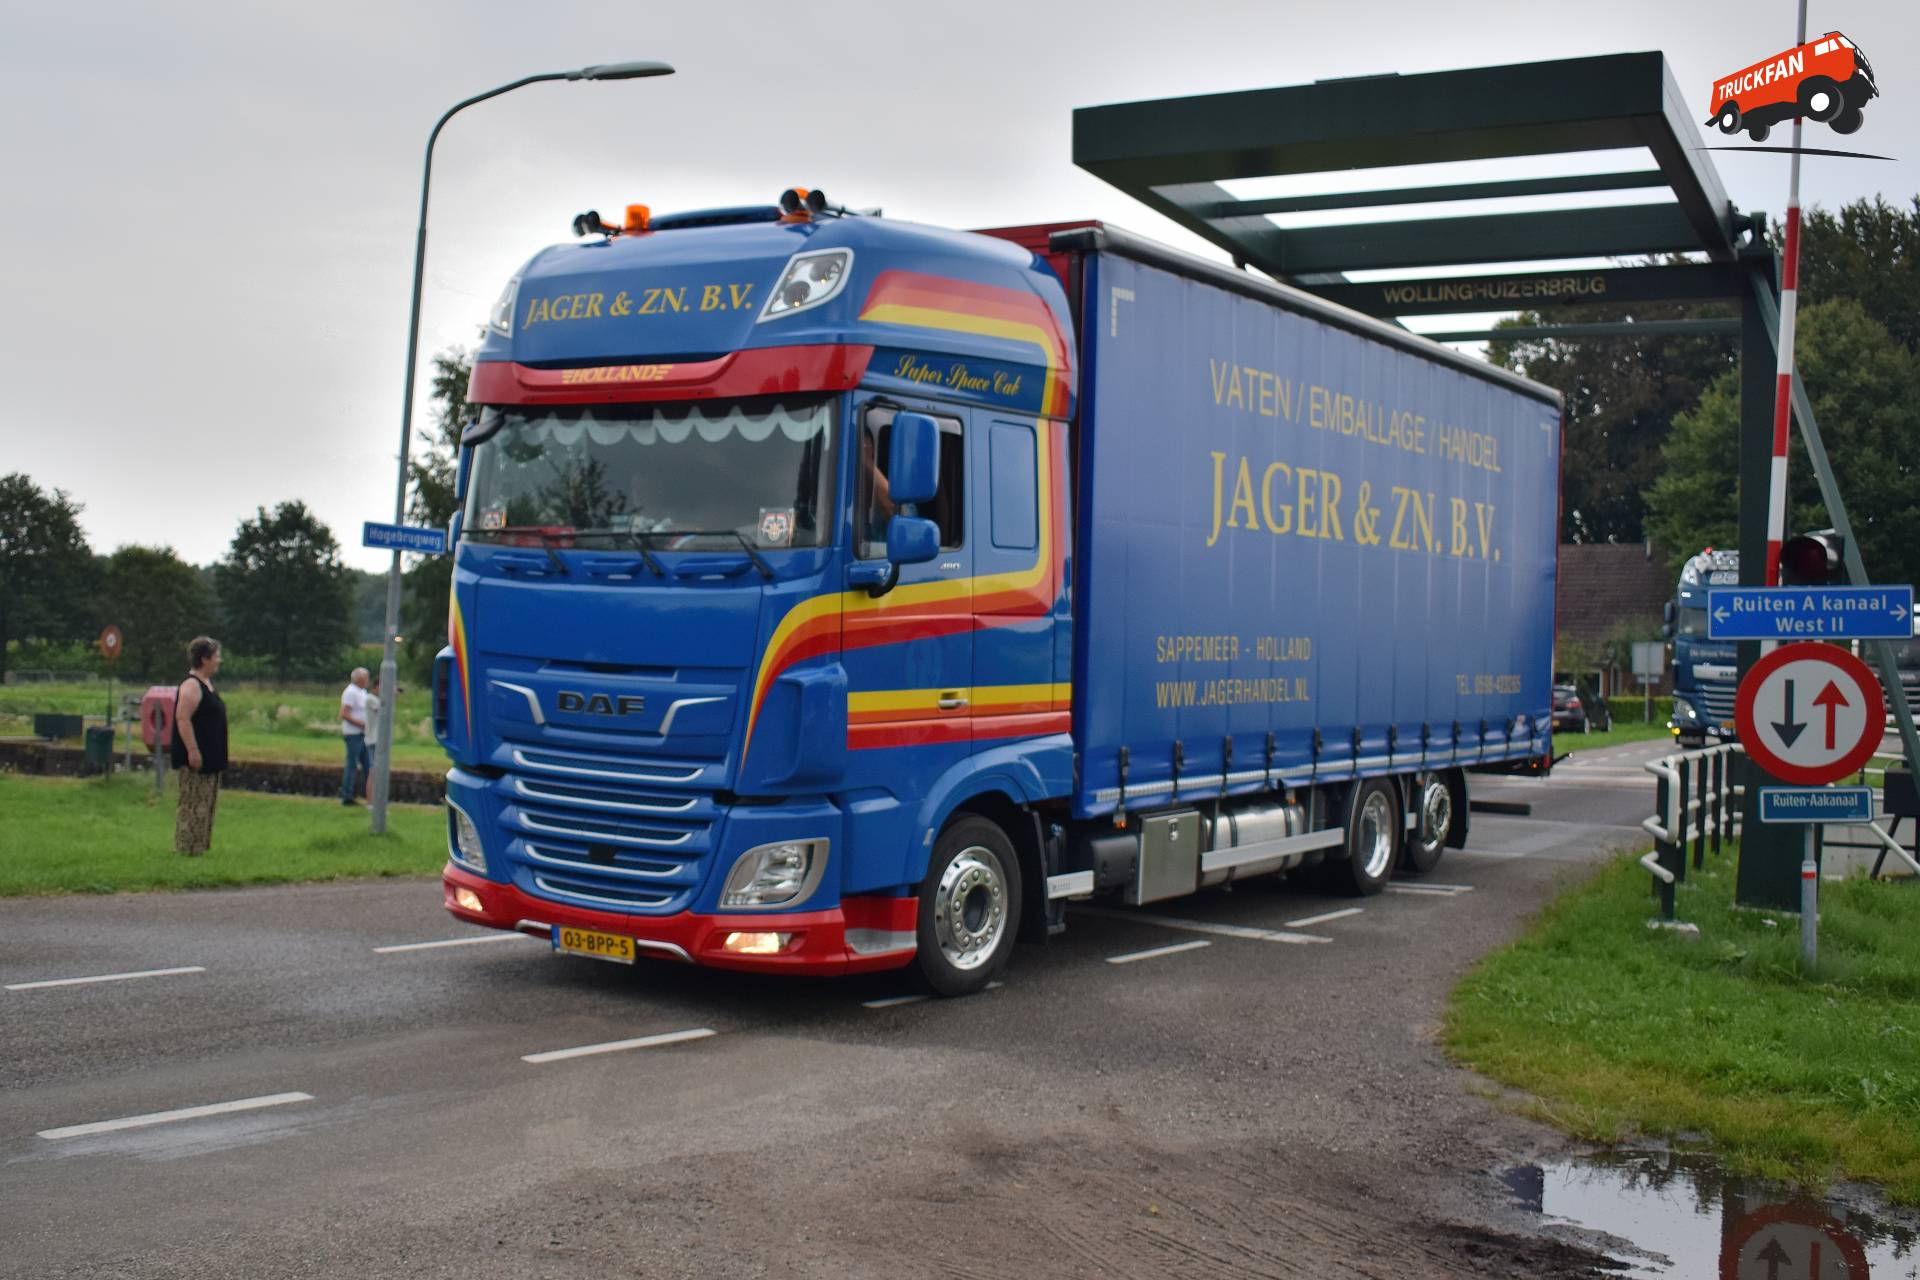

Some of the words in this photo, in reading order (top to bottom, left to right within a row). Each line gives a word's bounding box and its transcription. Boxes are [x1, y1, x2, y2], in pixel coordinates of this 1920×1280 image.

[1383, 276, 1607, 304] WOLLINGHUIZERBRUG
[522, 293, 604, 330] JAGER
[609, 291, 633, 316] &
[637, 287, 690, 315] ZN.
[700, 283, 754, 311] B.V.
[572, 364, 656, 385] HOLLAND
[894, 353, 942, 385] Super
[945, 363, 991, 392] Space
[993, 370, 1021, 396] Cab
[1209, 358, 1291, 422] VATEN
[1310, 385, 1425, 455] EMBALLAGE
[1439, 422, 1502, 473] HANDEL
[1206, 450, 1345, 548] JAGER
[1353, 480, 1381, 546] &
[1389, 485, 1442, 554] ZN.
[1450, 496, 1501, 562] B.V.
[1732, 596, 1796, 613] Ruiten
[1802, 595, 1815, 611] A
[1822, 594, 1888, 612] kanaal
[1776, 616, 1824, 632] West
[1156, 635, 1240, 663] SAPPEMEER
[1256, 636, 1312, 661] HOLLAND
[557, 690, 645, 716] DAF
[1156, 677, 1310, 708] WWW.JAGERHANDEL.NL
[1773, 793, 1858, 807] Ruiten-Aakanaal
[564, 930, 629, 955] 03-BPP-5
